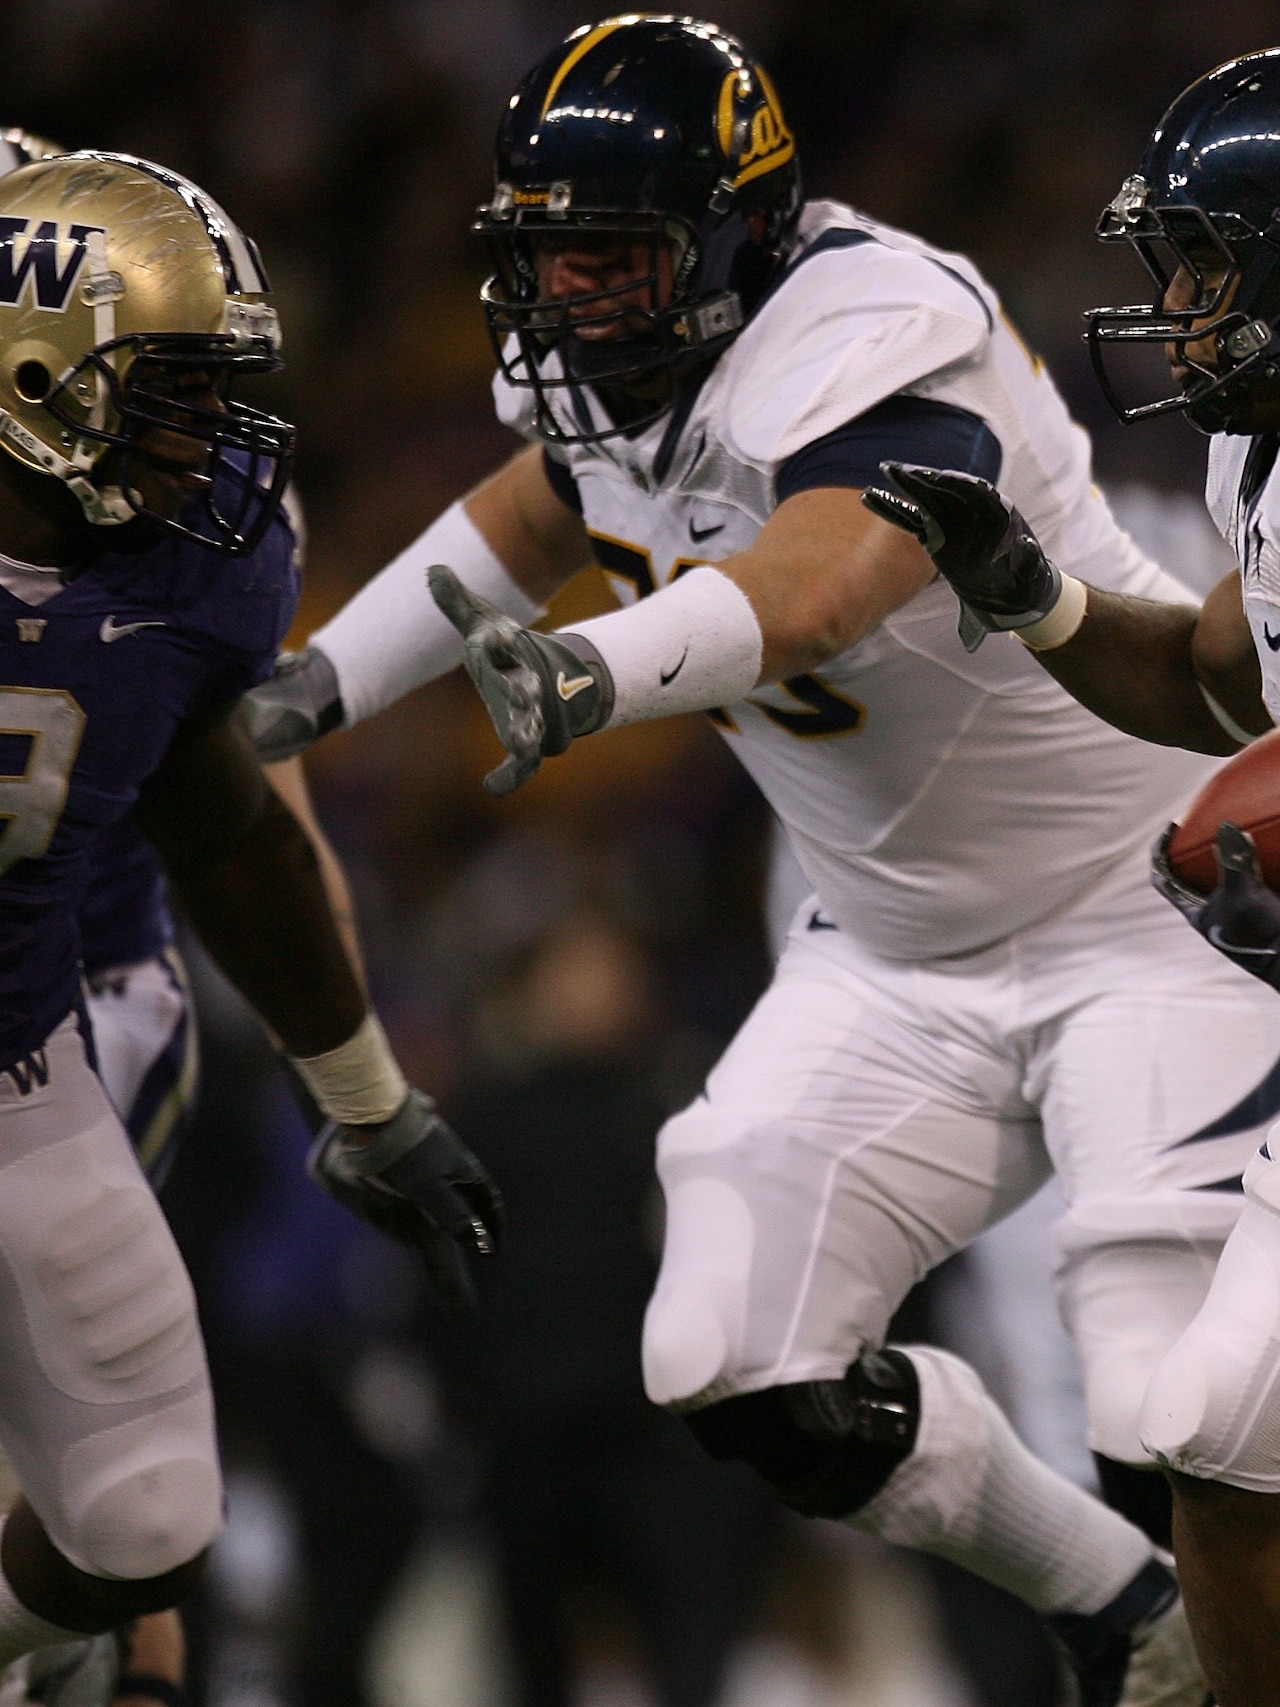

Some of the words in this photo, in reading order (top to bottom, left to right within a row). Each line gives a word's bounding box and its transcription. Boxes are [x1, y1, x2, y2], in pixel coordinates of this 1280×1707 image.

[717, 64, 795, 190] Cal
[513, 189, 551, 205] Bears
[0, 214, 110, 314] W
